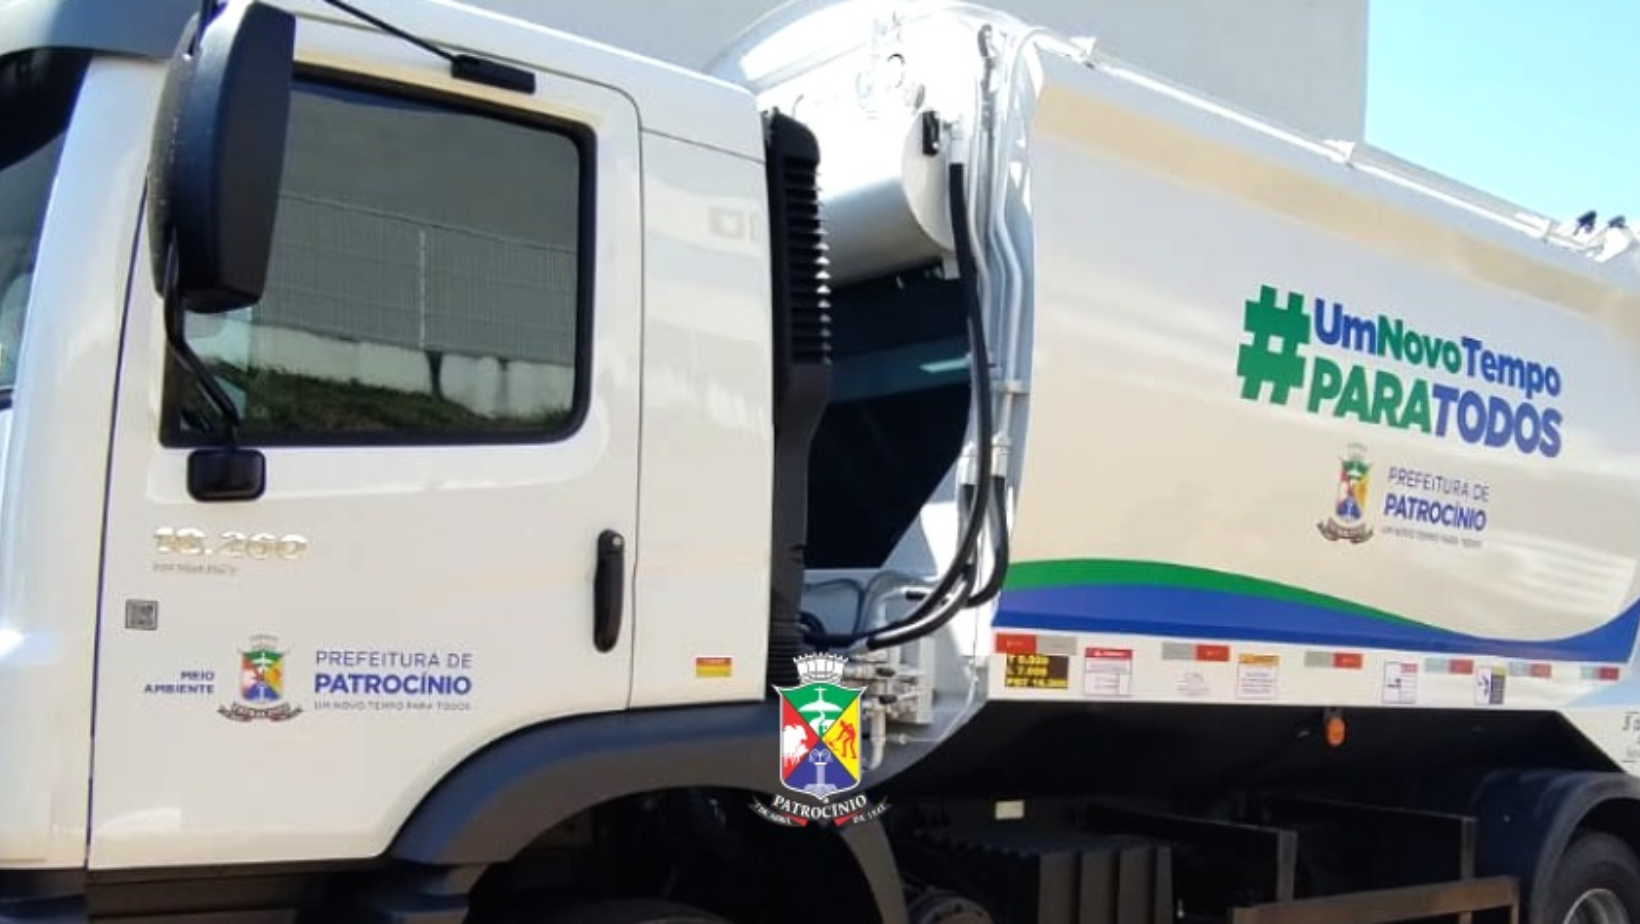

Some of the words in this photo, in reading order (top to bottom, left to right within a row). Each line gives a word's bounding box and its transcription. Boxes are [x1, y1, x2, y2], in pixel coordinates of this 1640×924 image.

[1387, 467, 1468, 497] PREFEITURA
[1472, 482, 1490, 502] DE
[1384, 493, 1487, 531] PATROCÍNIO
[316, 650, 440, 668] PREFEITURA
[447, 652, 472, 668] DE
[180, 670, 214, 681] MEIO
[314, 671, 472, 695] PATROCÍNIO
[144, 684, 214, 694] AMBIENTE
